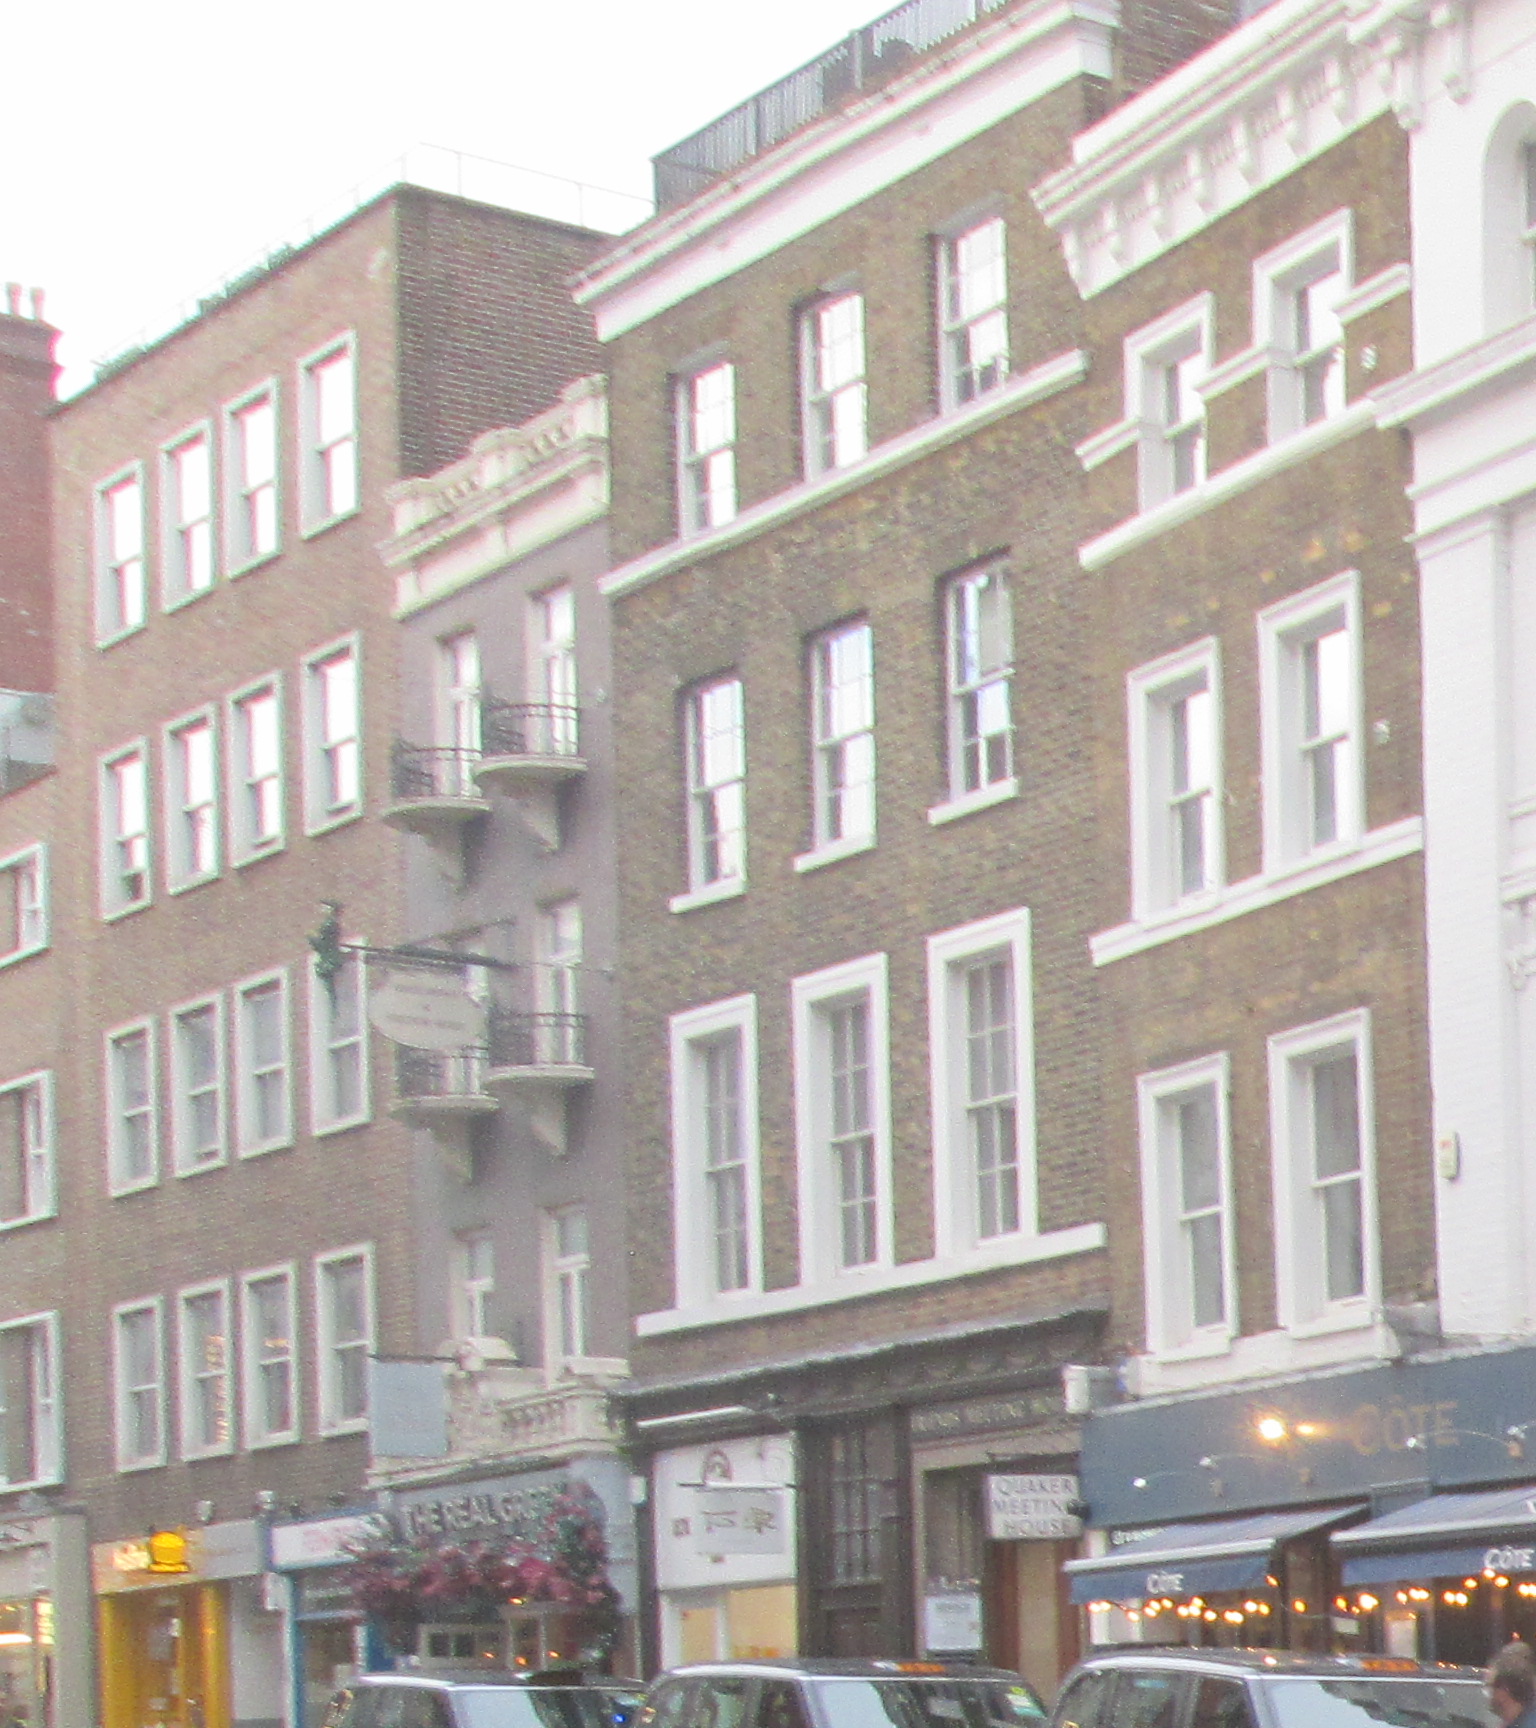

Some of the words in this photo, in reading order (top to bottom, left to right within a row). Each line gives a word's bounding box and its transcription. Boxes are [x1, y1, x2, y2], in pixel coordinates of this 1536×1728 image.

[995, 1477, 1074, 1496] QUAKER
[993, 1498, 1067, 1515] MEETIN
[1003, 1519, 1074, 1536] HOUSE
